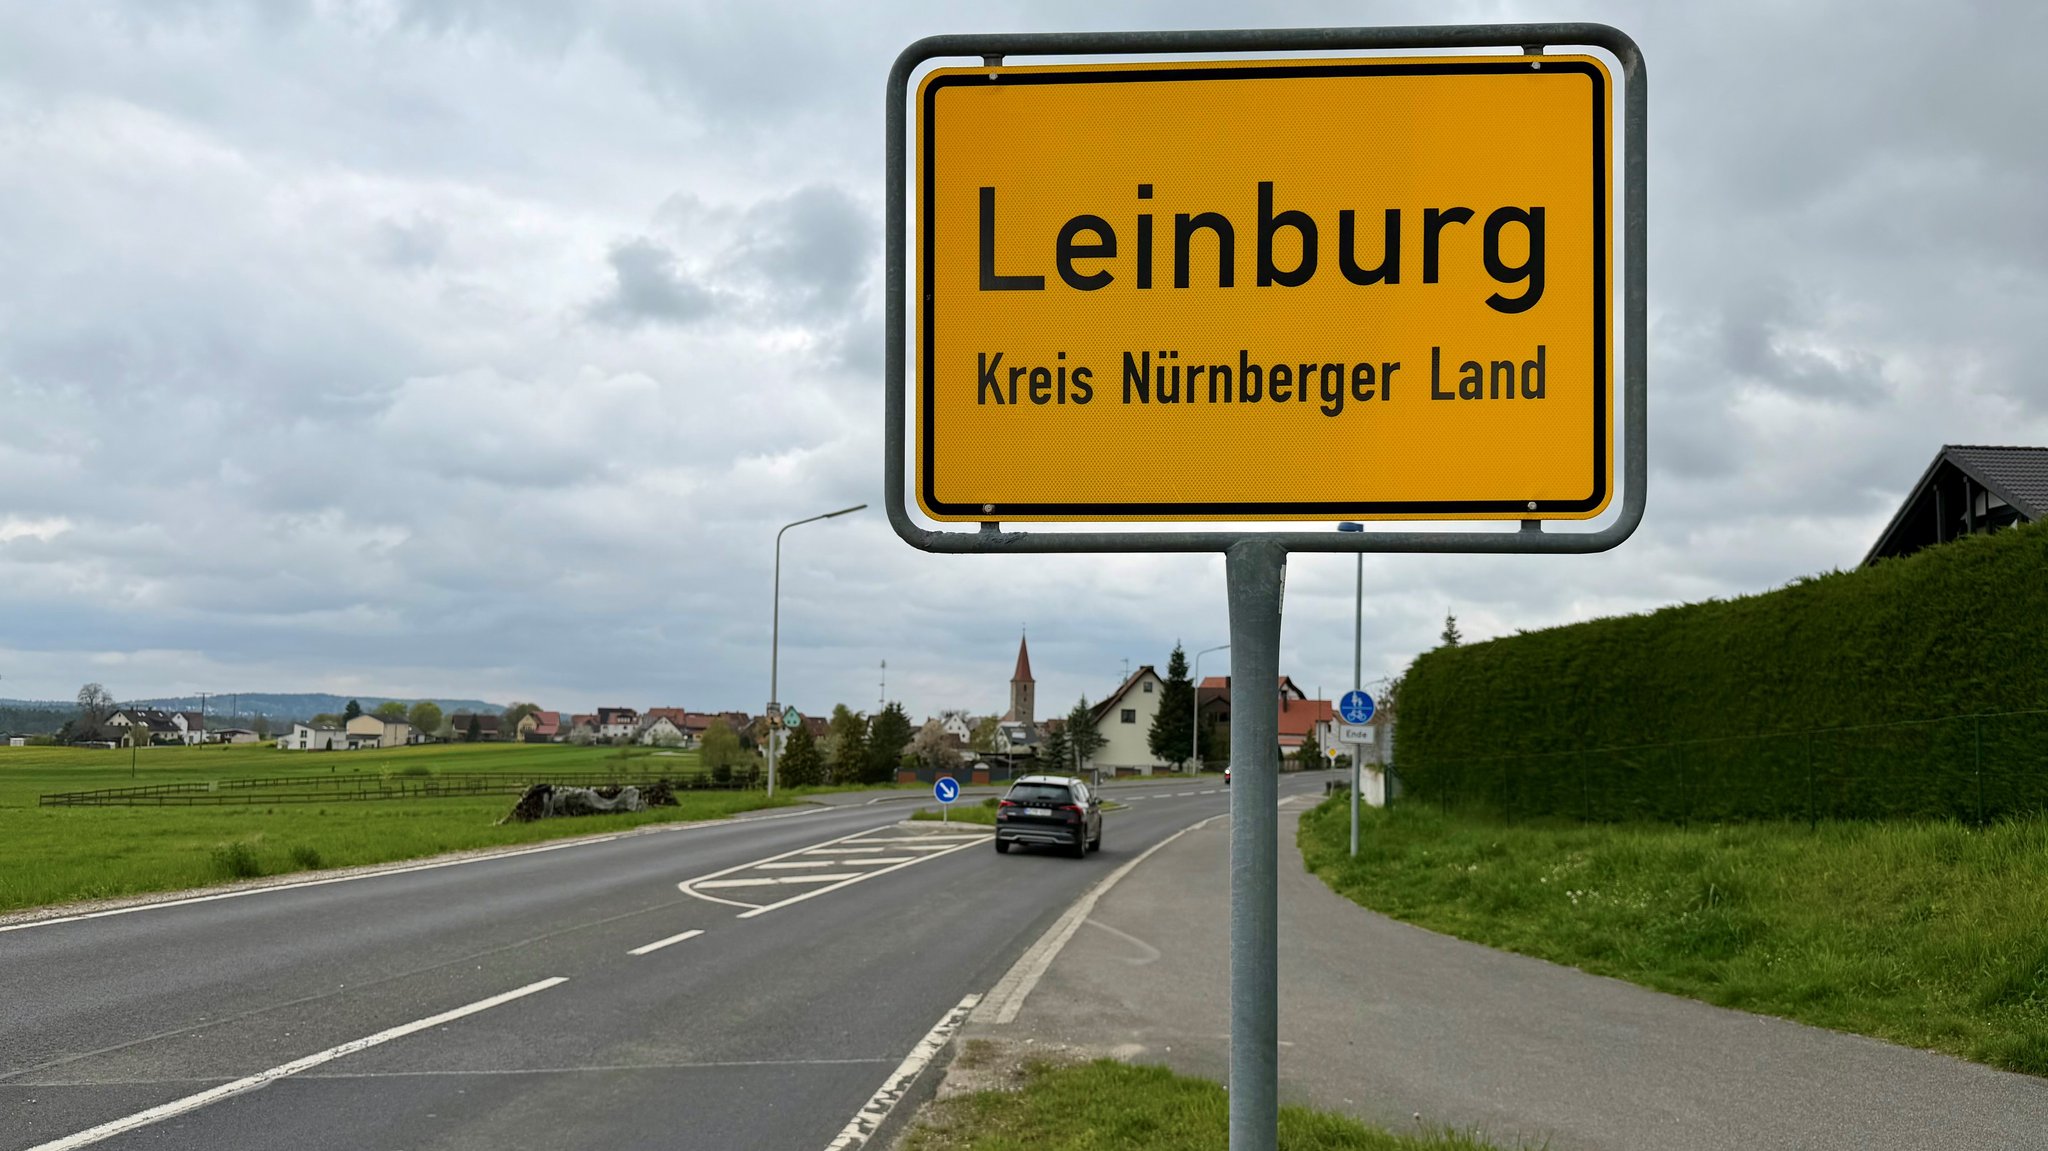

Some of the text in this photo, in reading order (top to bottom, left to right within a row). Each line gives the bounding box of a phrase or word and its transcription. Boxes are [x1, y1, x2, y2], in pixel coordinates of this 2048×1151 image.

[978, 181, 1546, 314] Leinburg
[977, 345, 1546, 418] Kreis Nürnberger Land
[1346, 729, 1367, 738] Ende
